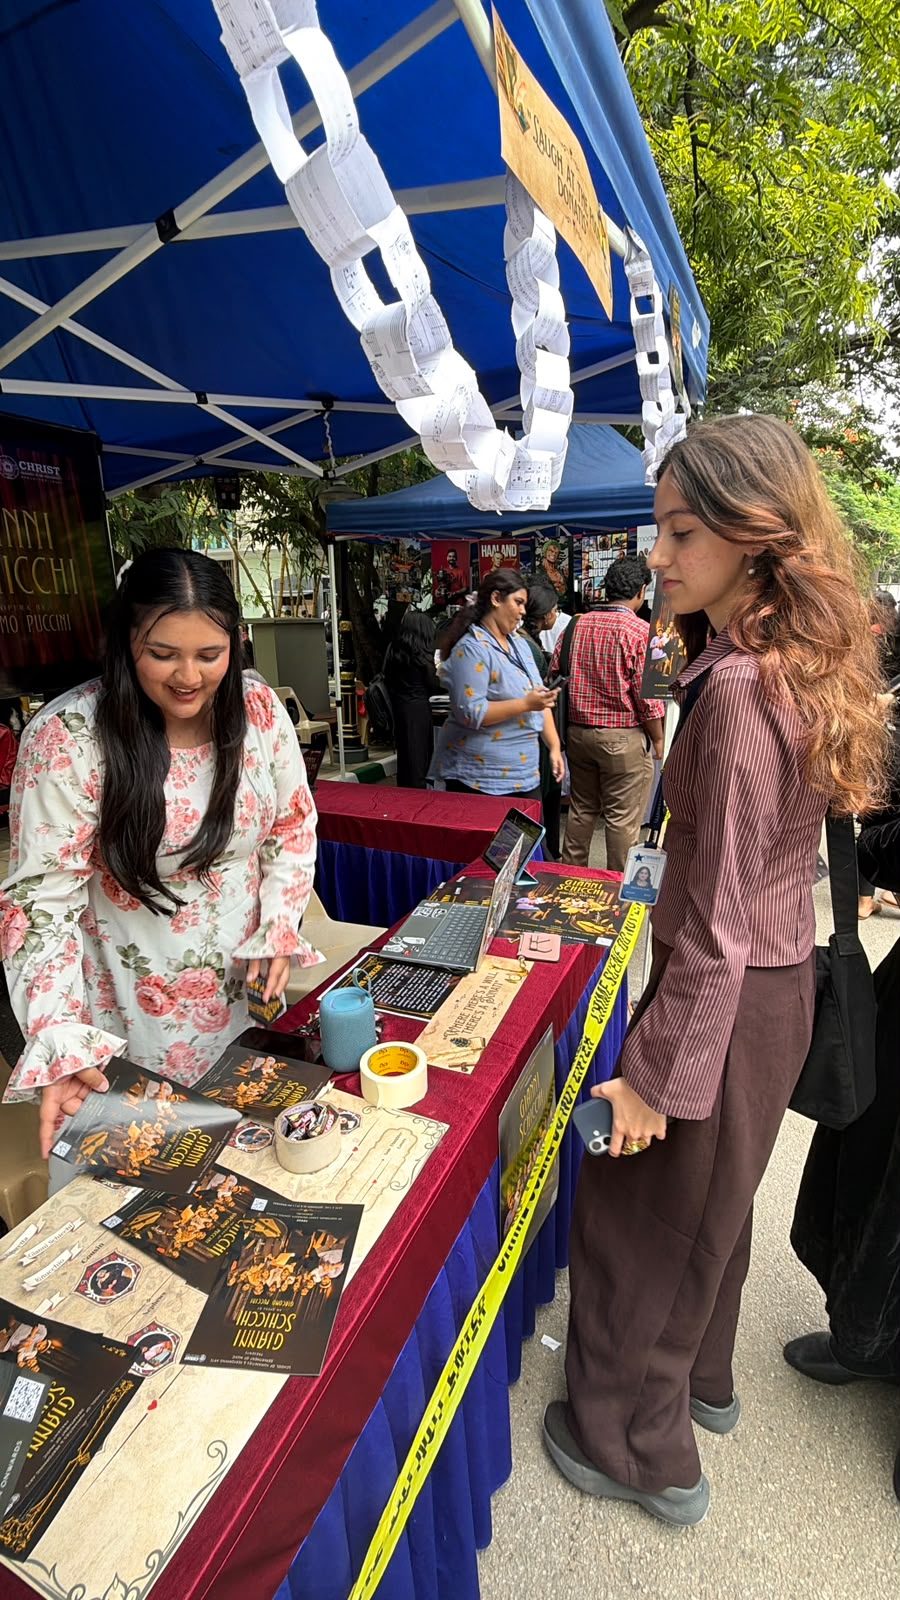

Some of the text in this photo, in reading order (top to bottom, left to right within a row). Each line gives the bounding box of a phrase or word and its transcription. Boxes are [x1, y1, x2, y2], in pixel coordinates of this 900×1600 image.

[19, 460, 61, 476] CHRIST
[0, 508, 53, 550] NNI
[0, 556, 78, 595] ICCHI
[26, 614, 72, 633] PUCCINI
[556, 884, 604, 896] SCHICCHI
[564, 880, 602, 890] GIANNI
[482, 972, 499, 985] WILL
[520, 1072, 540, 1118] GIANNI
[167, 1124, 202, 1168] SCHICCHI
[183, 1134, 212, 1167] GIANNI
[81, 1242, 105, 1264] Cousin
[236, 1310, 296, 1332] SCHICCHI
[233, 1330, 284, 1350] GIANNI
[26, 1396, 75, 1459] GIANN
